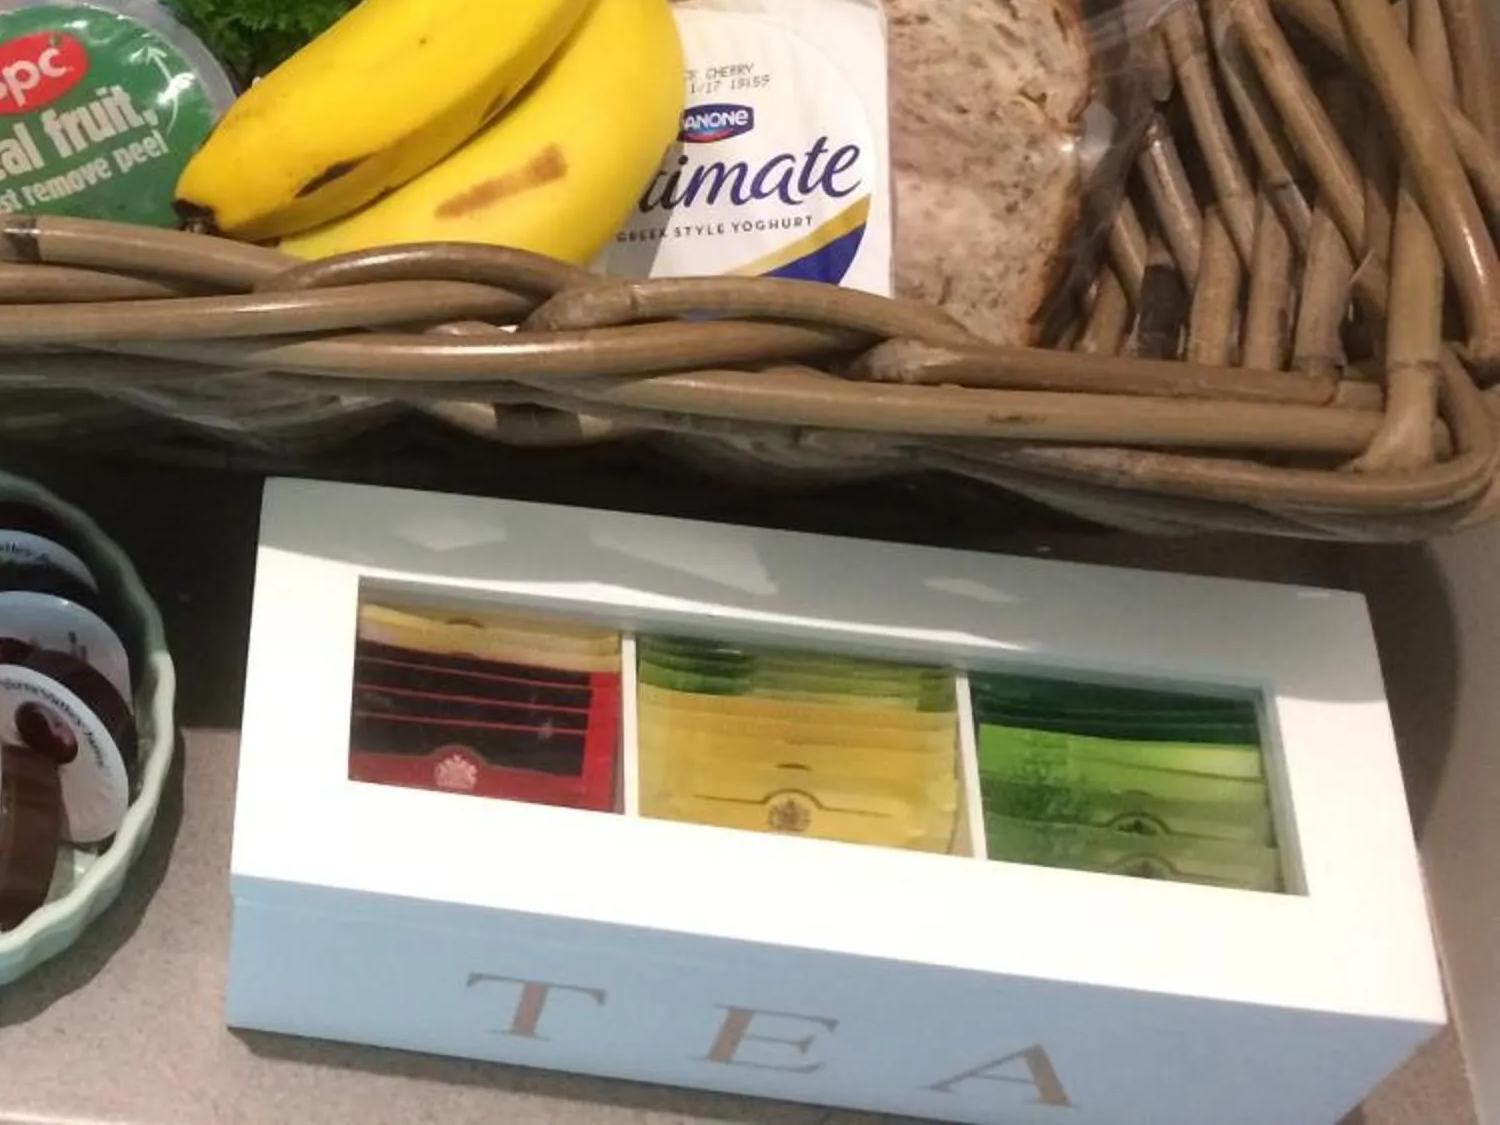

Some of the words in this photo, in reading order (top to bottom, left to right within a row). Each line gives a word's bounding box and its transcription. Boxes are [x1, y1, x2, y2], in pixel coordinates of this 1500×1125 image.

[683, 109, 749, 130] ANONE
[22, 155, 113, 207] remove
[112, 129, 170, 174] peel
[674, 223, 726, 238] STYLE
[731, 215, 813, 234] YOGHURT
[465, 971, 1079, 1109] TEA
